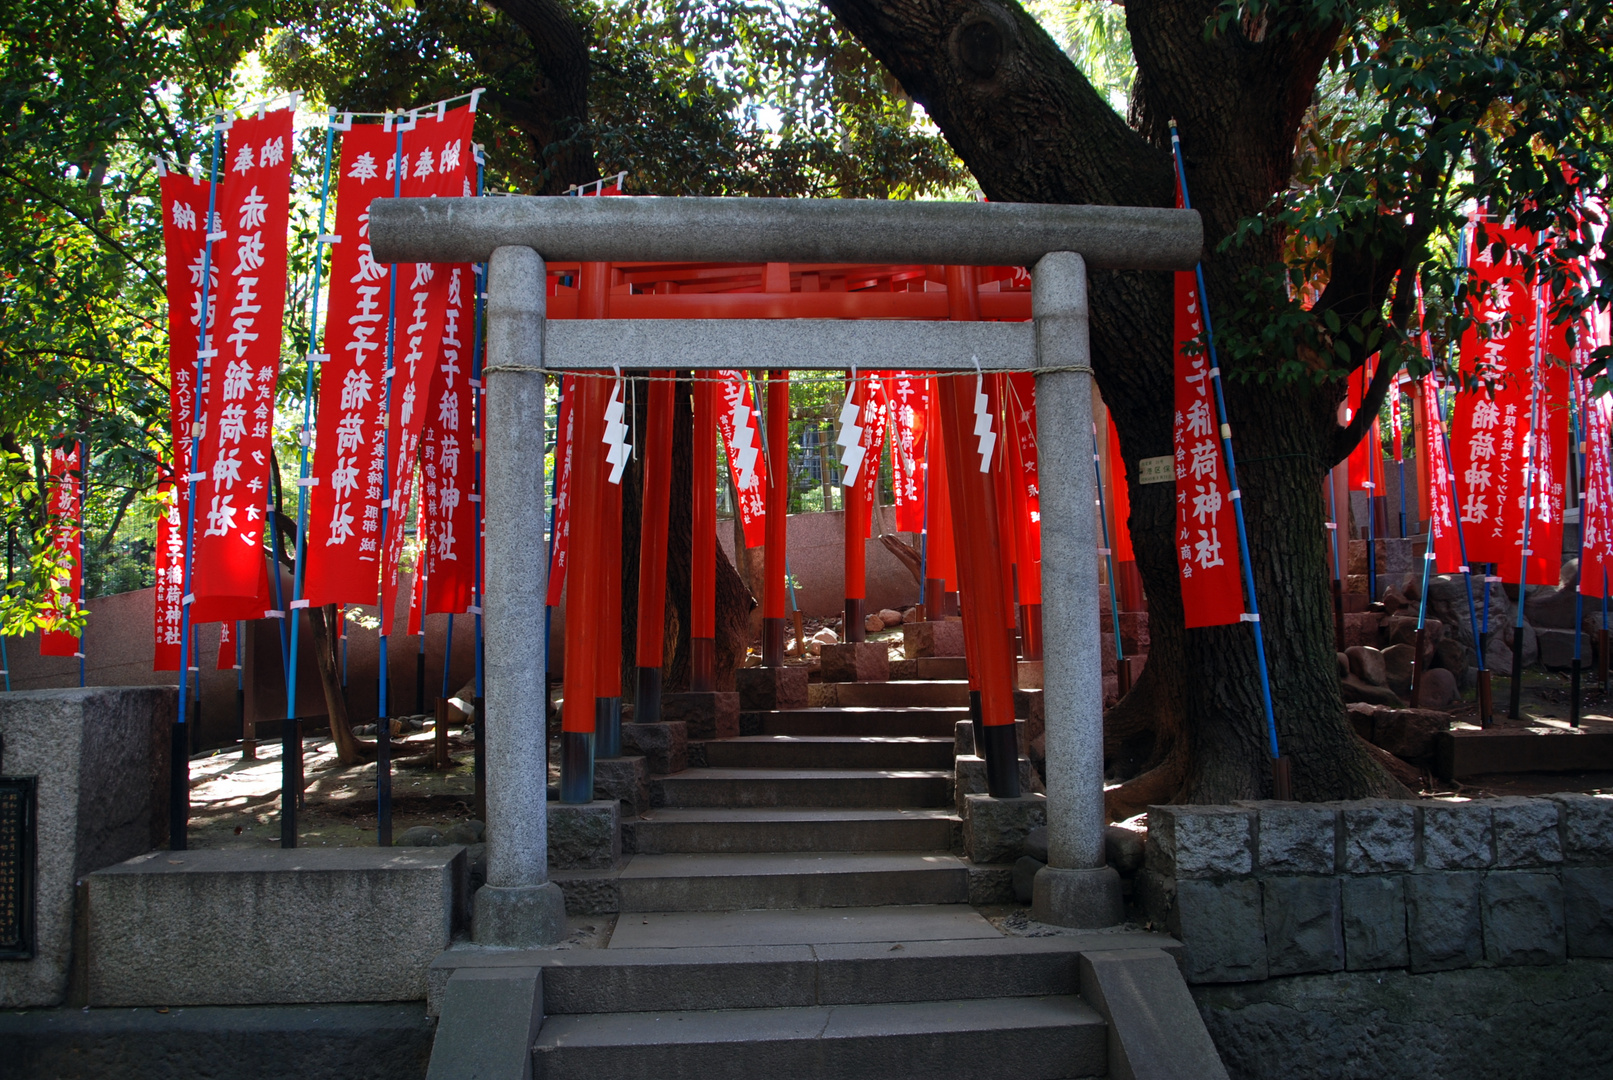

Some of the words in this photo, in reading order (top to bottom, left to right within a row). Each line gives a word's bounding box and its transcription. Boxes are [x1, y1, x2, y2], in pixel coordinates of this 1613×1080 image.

[1175, 410, 1188, 480] 株式会社
[1186, 290, 1224, 571] 子稲荷神社
[1177, 489, 1193, 579] オール商会
